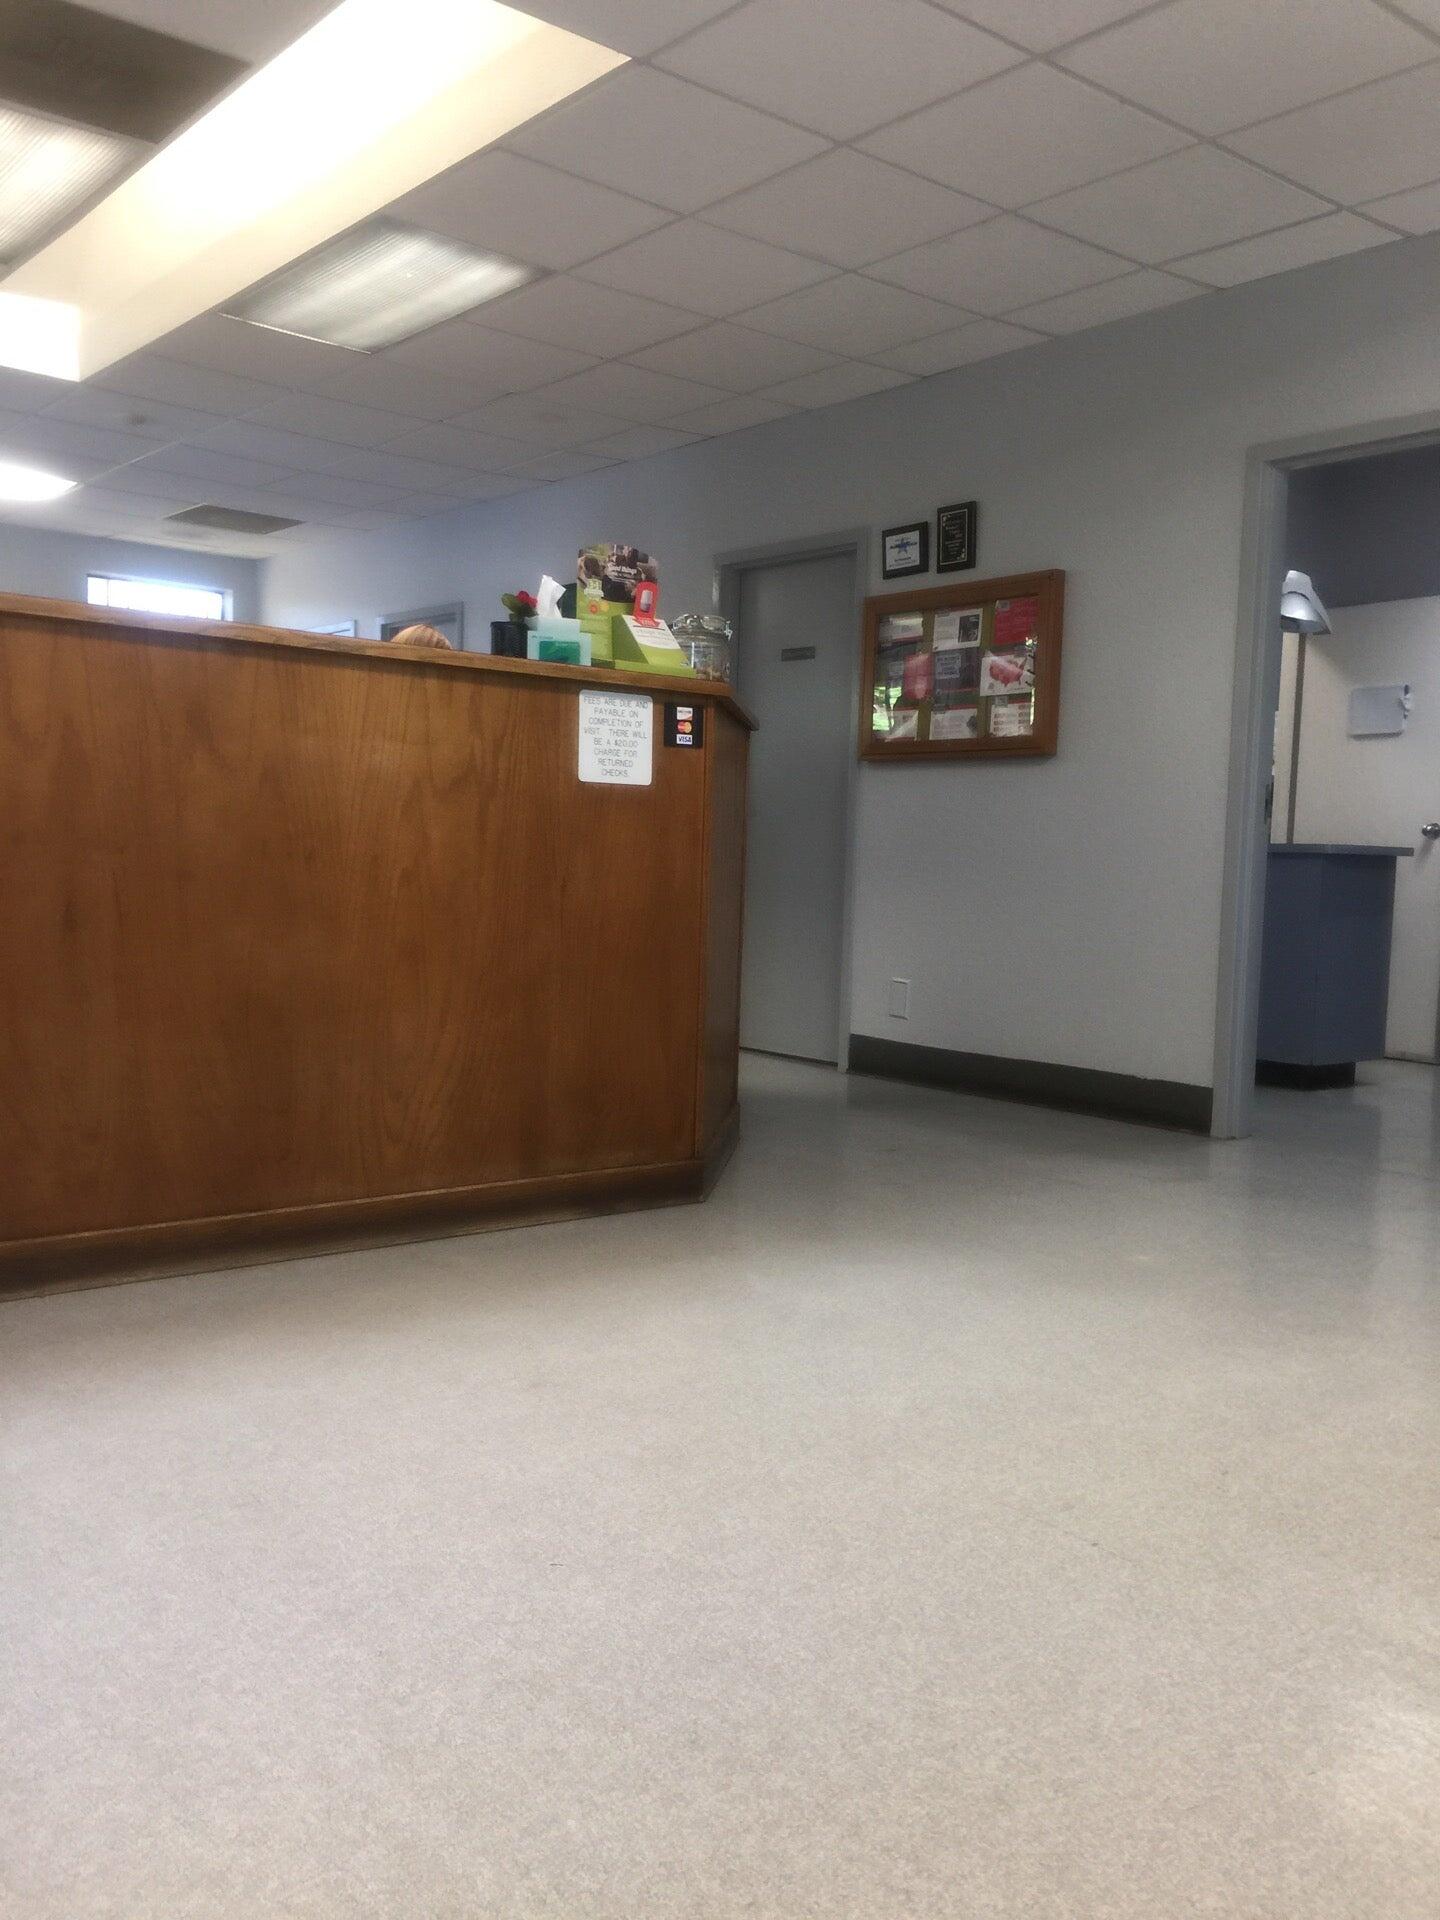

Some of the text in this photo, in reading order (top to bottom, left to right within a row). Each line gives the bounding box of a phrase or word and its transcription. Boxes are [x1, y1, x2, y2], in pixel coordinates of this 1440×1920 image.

[584, 696, 648, 710] FEES ARE DUE AND
[593, 706, 639, 719] PAYABLE ON
[588, 717, 643, 728] COMPLETION OF
[609, 728, 630, 738] THERE
[632, 730, 648, 739] WILL
[593, 737, 603, 746] BE
[593, 748, 638, 758] CHARGE FOR
[598, 758, 633, 768] RETURNED
